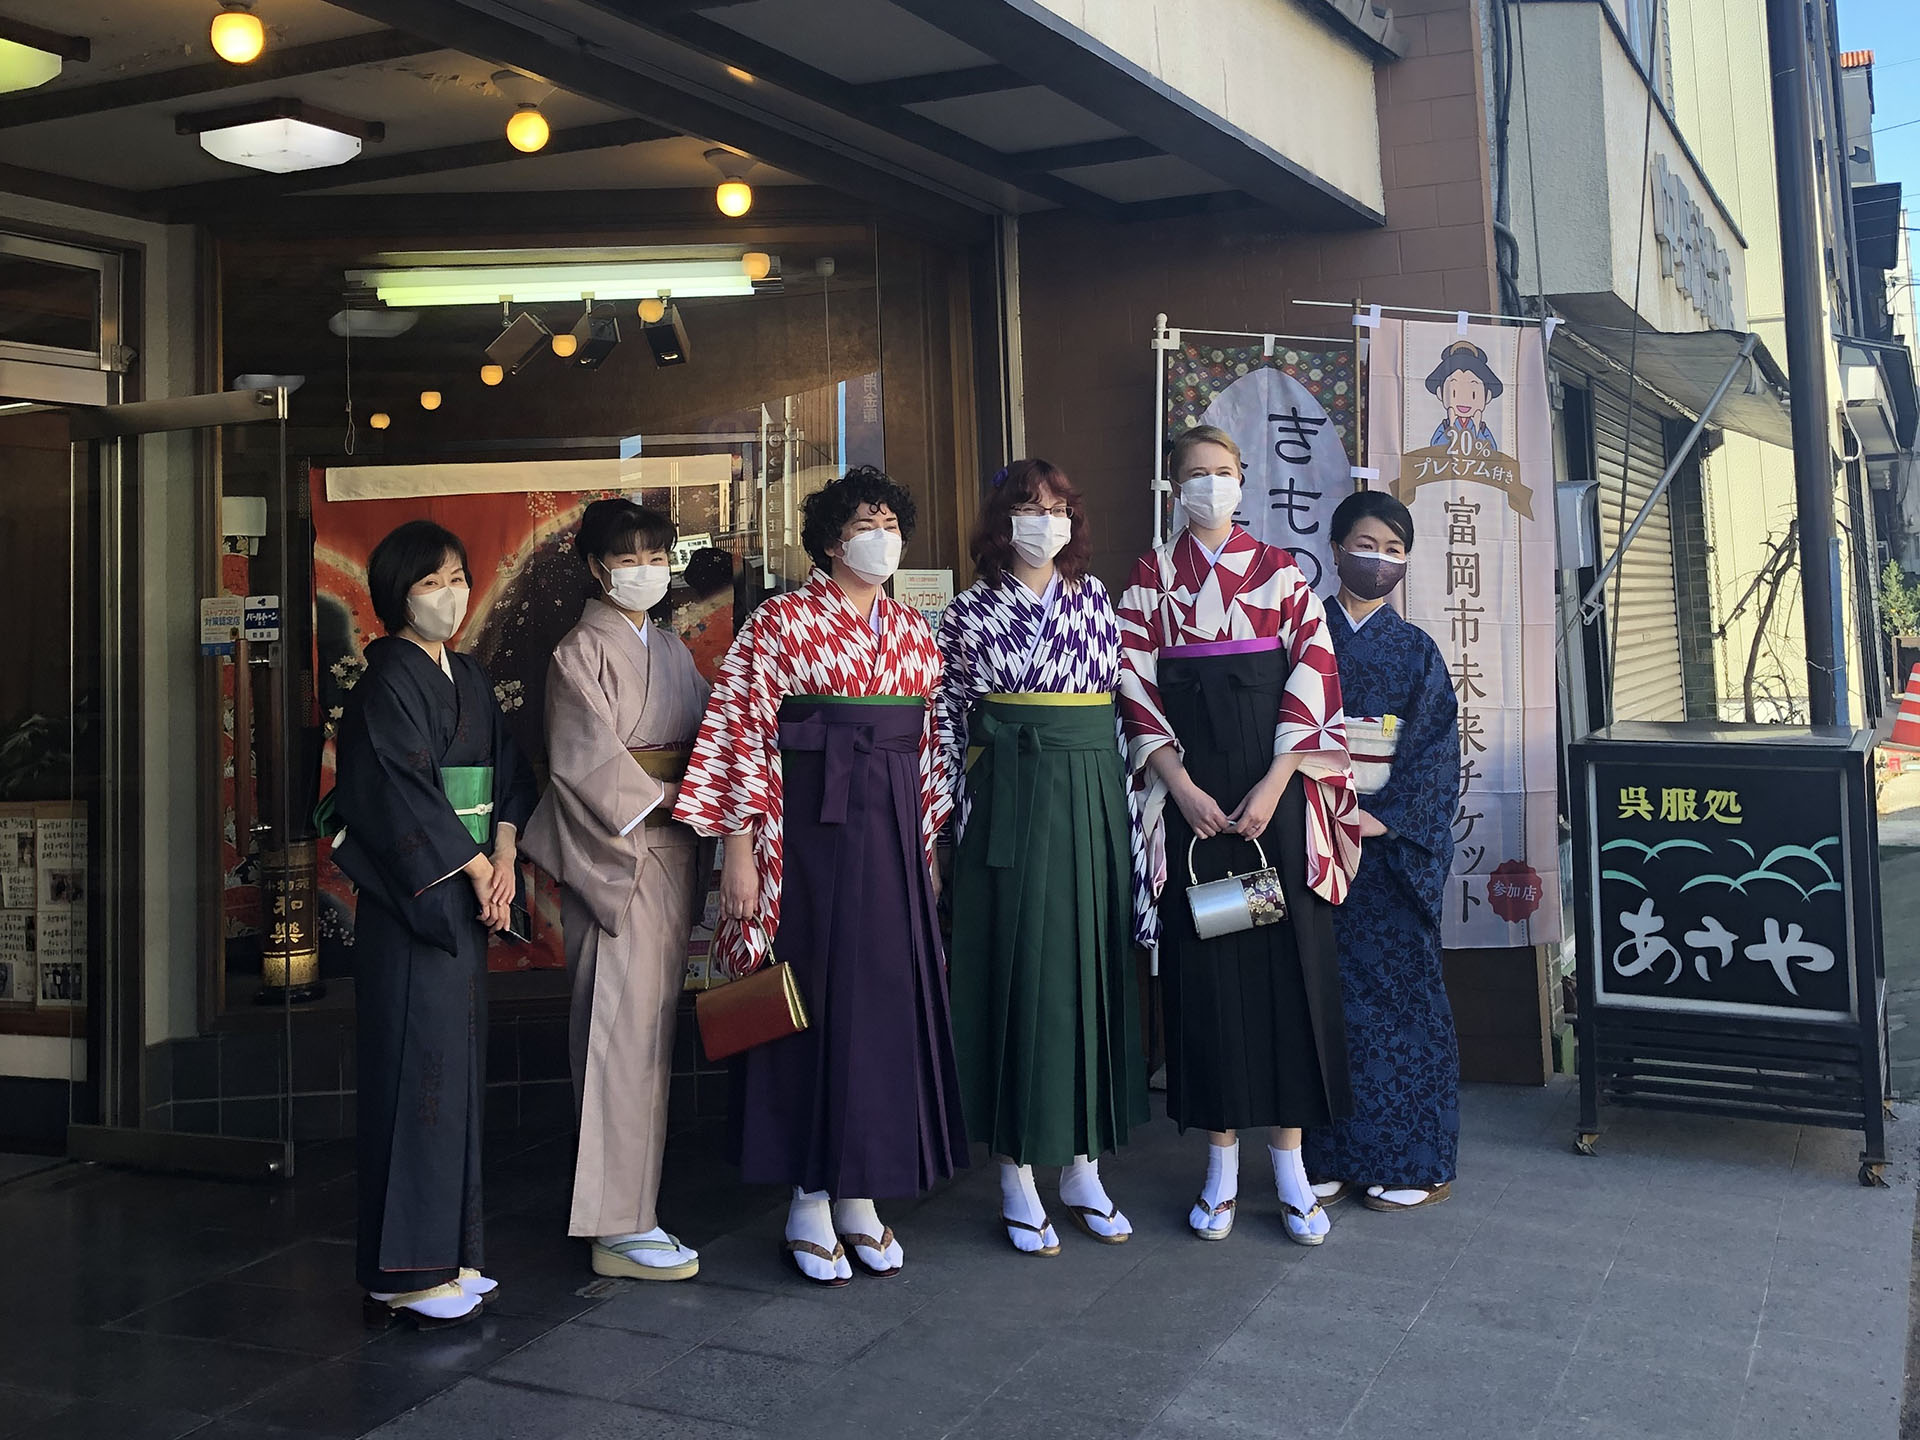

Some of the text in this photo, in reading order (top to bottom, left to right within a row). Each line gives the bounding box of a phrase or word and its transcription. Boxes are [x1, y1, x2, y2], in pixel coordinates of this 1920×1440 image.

[1446, 429, 1491, 458] 20%
[1414, 456, 1514, 485] プレミアム付き
[1443, 495, 1488, 924] 富岡市未来チケット
[1617, 785, 1744, 825] 呉服処
[1492, 880, 1537, 902] 参加店
[1612, 897, 1836, 997] あさや
